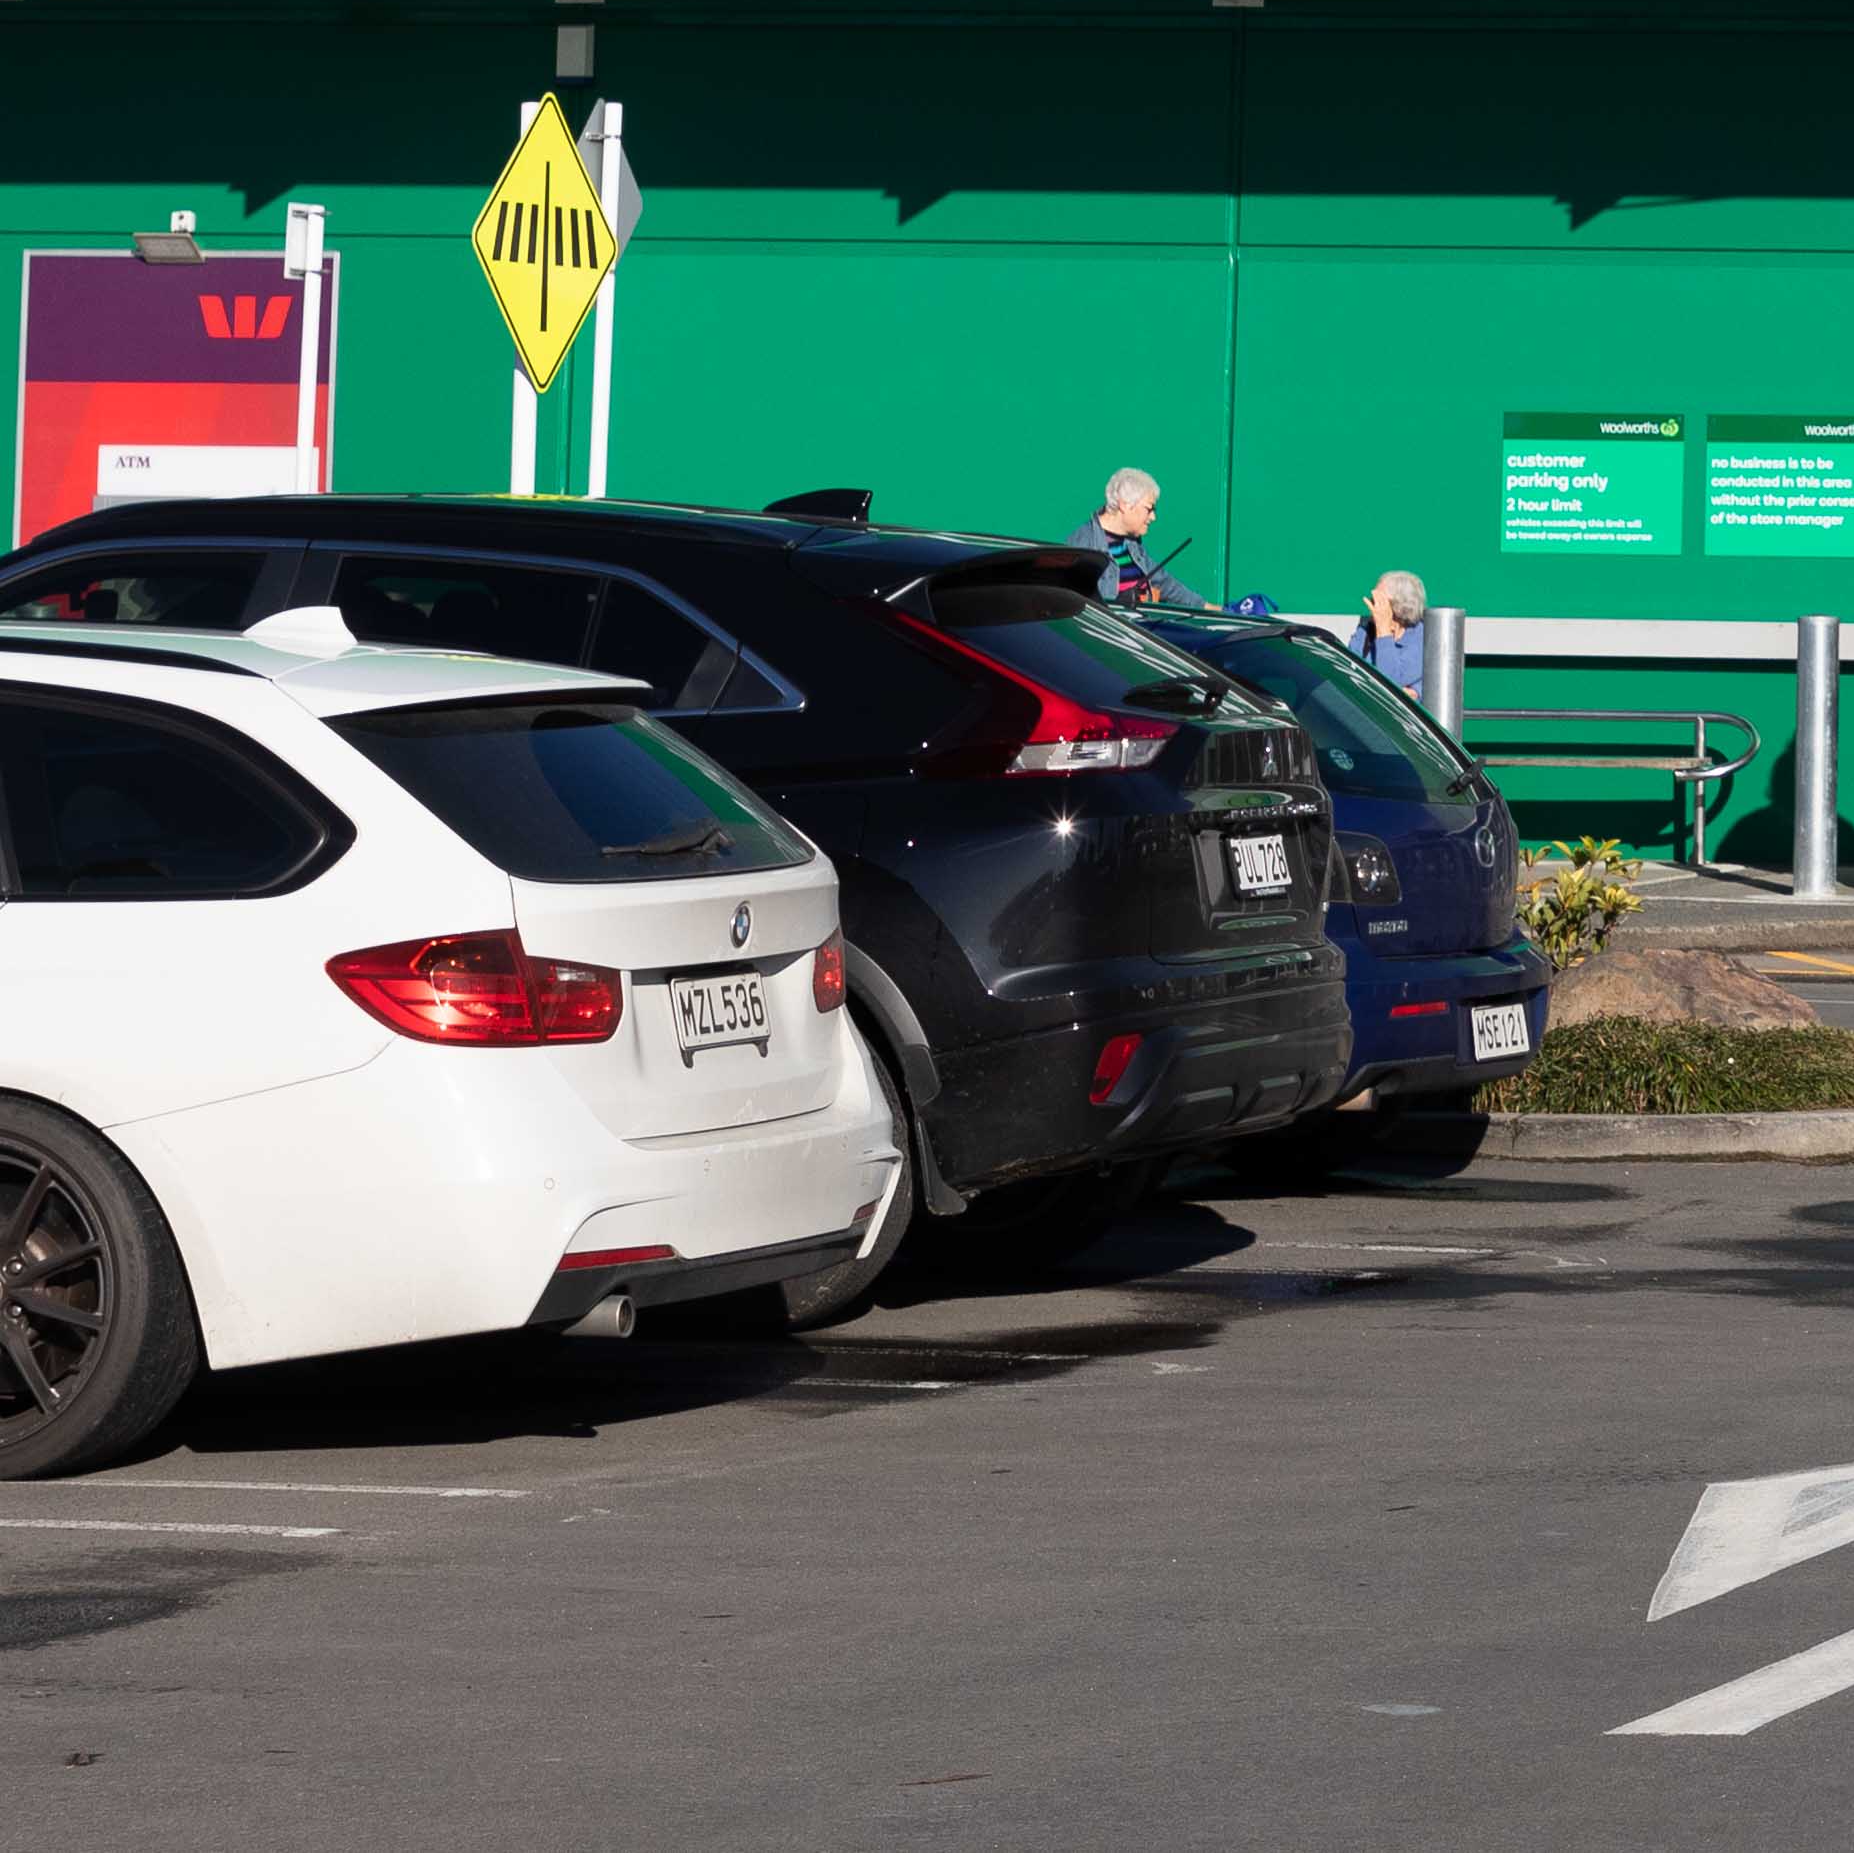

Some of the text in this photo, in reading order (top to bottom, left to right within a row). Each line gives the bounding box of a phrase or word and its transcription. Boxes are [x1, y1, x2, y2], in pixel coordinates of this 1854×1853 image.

[115, 456, 151, 469] ATM
[1506, 453, 1586, 468] customer
[1711, 456, 1835, 470] no business is to be
[1506, 472, 1608, 493] parking only
[1711, 474, 1853, 489] conducted in this area
[1506, 497, 1583, 512] 2 hour limit
[1710, 493, 1761, 506] without
[1762, 493, 1786, 506] the
[1787, 494, 1817, 510] prior
[1710, 511, 1845, 529] of the store manager
[1232, 841, 1288, 884] PUL728
[679, 981, 765, 1037] MZL536
